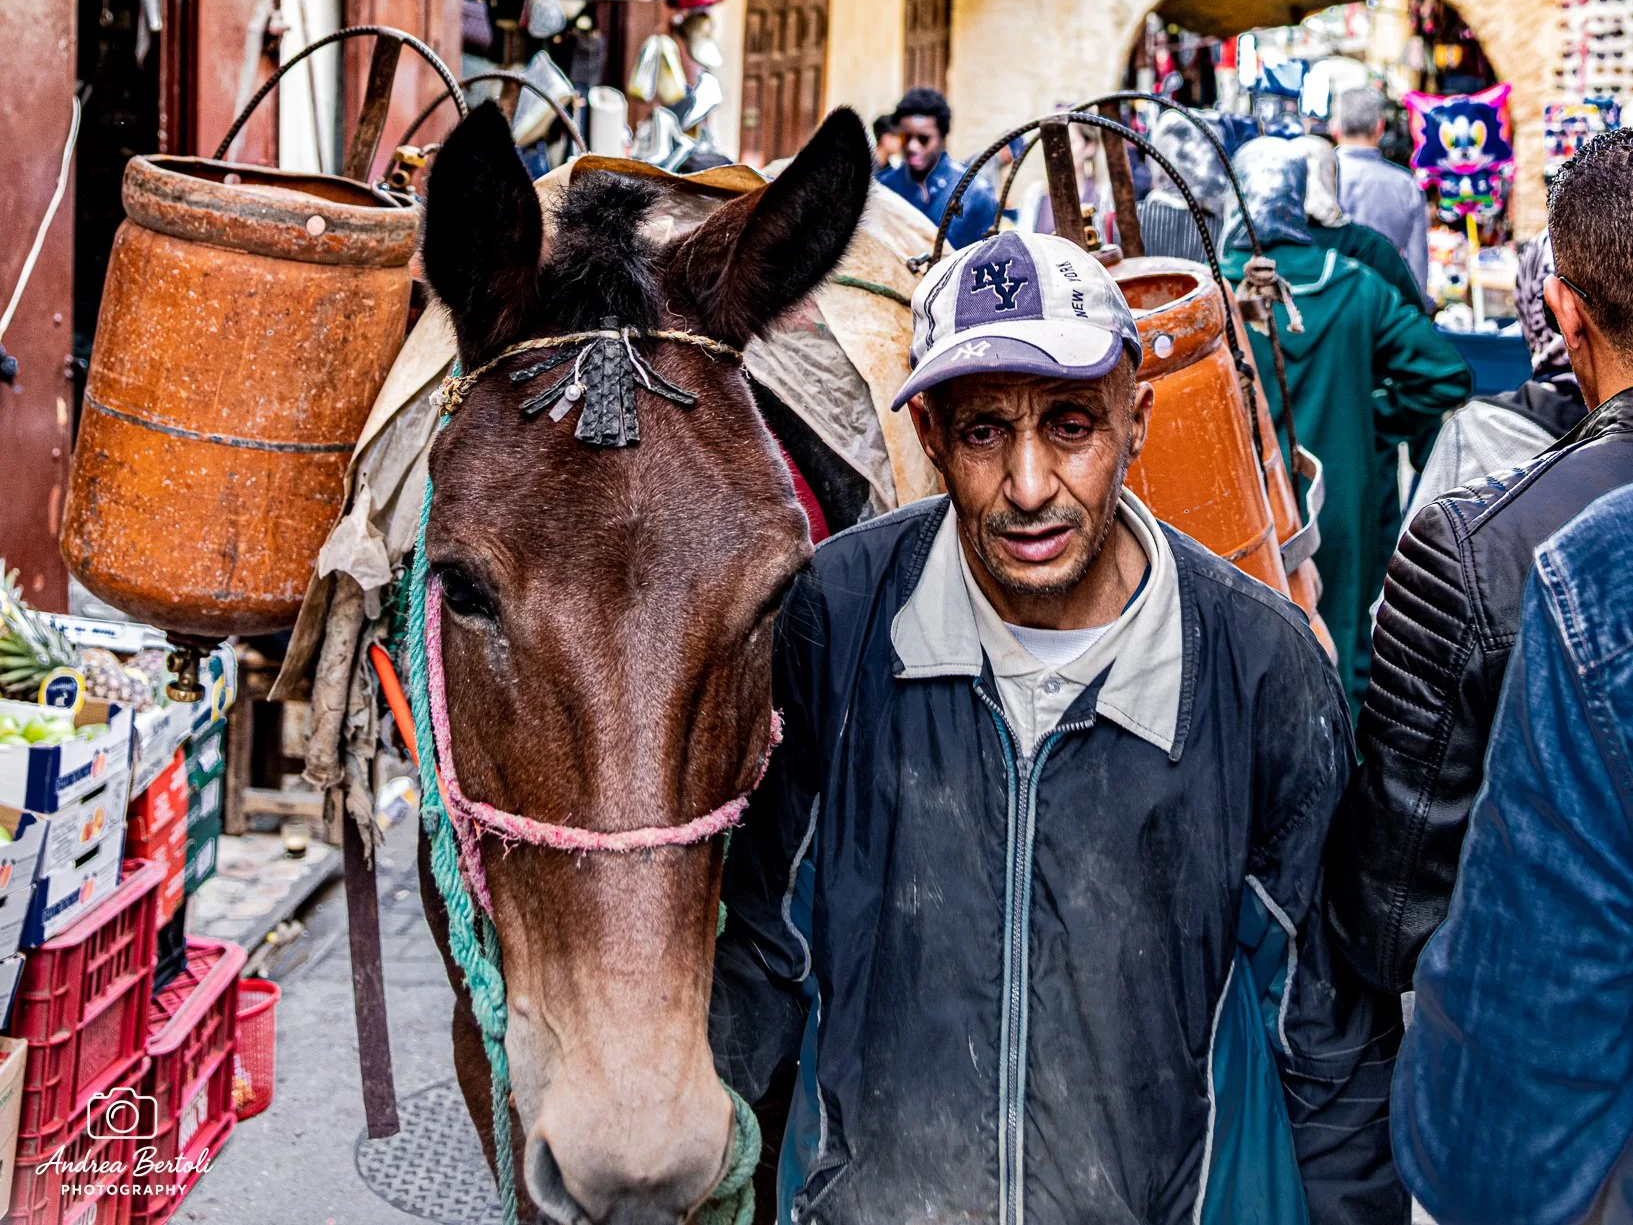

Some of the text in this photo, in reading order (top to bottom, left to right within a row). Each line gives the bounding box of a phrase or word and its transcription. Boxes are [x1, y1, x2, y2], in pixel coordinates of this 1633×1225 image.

[971, 260, 1028, 312] NY
[1056, 261, 1089, 318] NEW YORK
